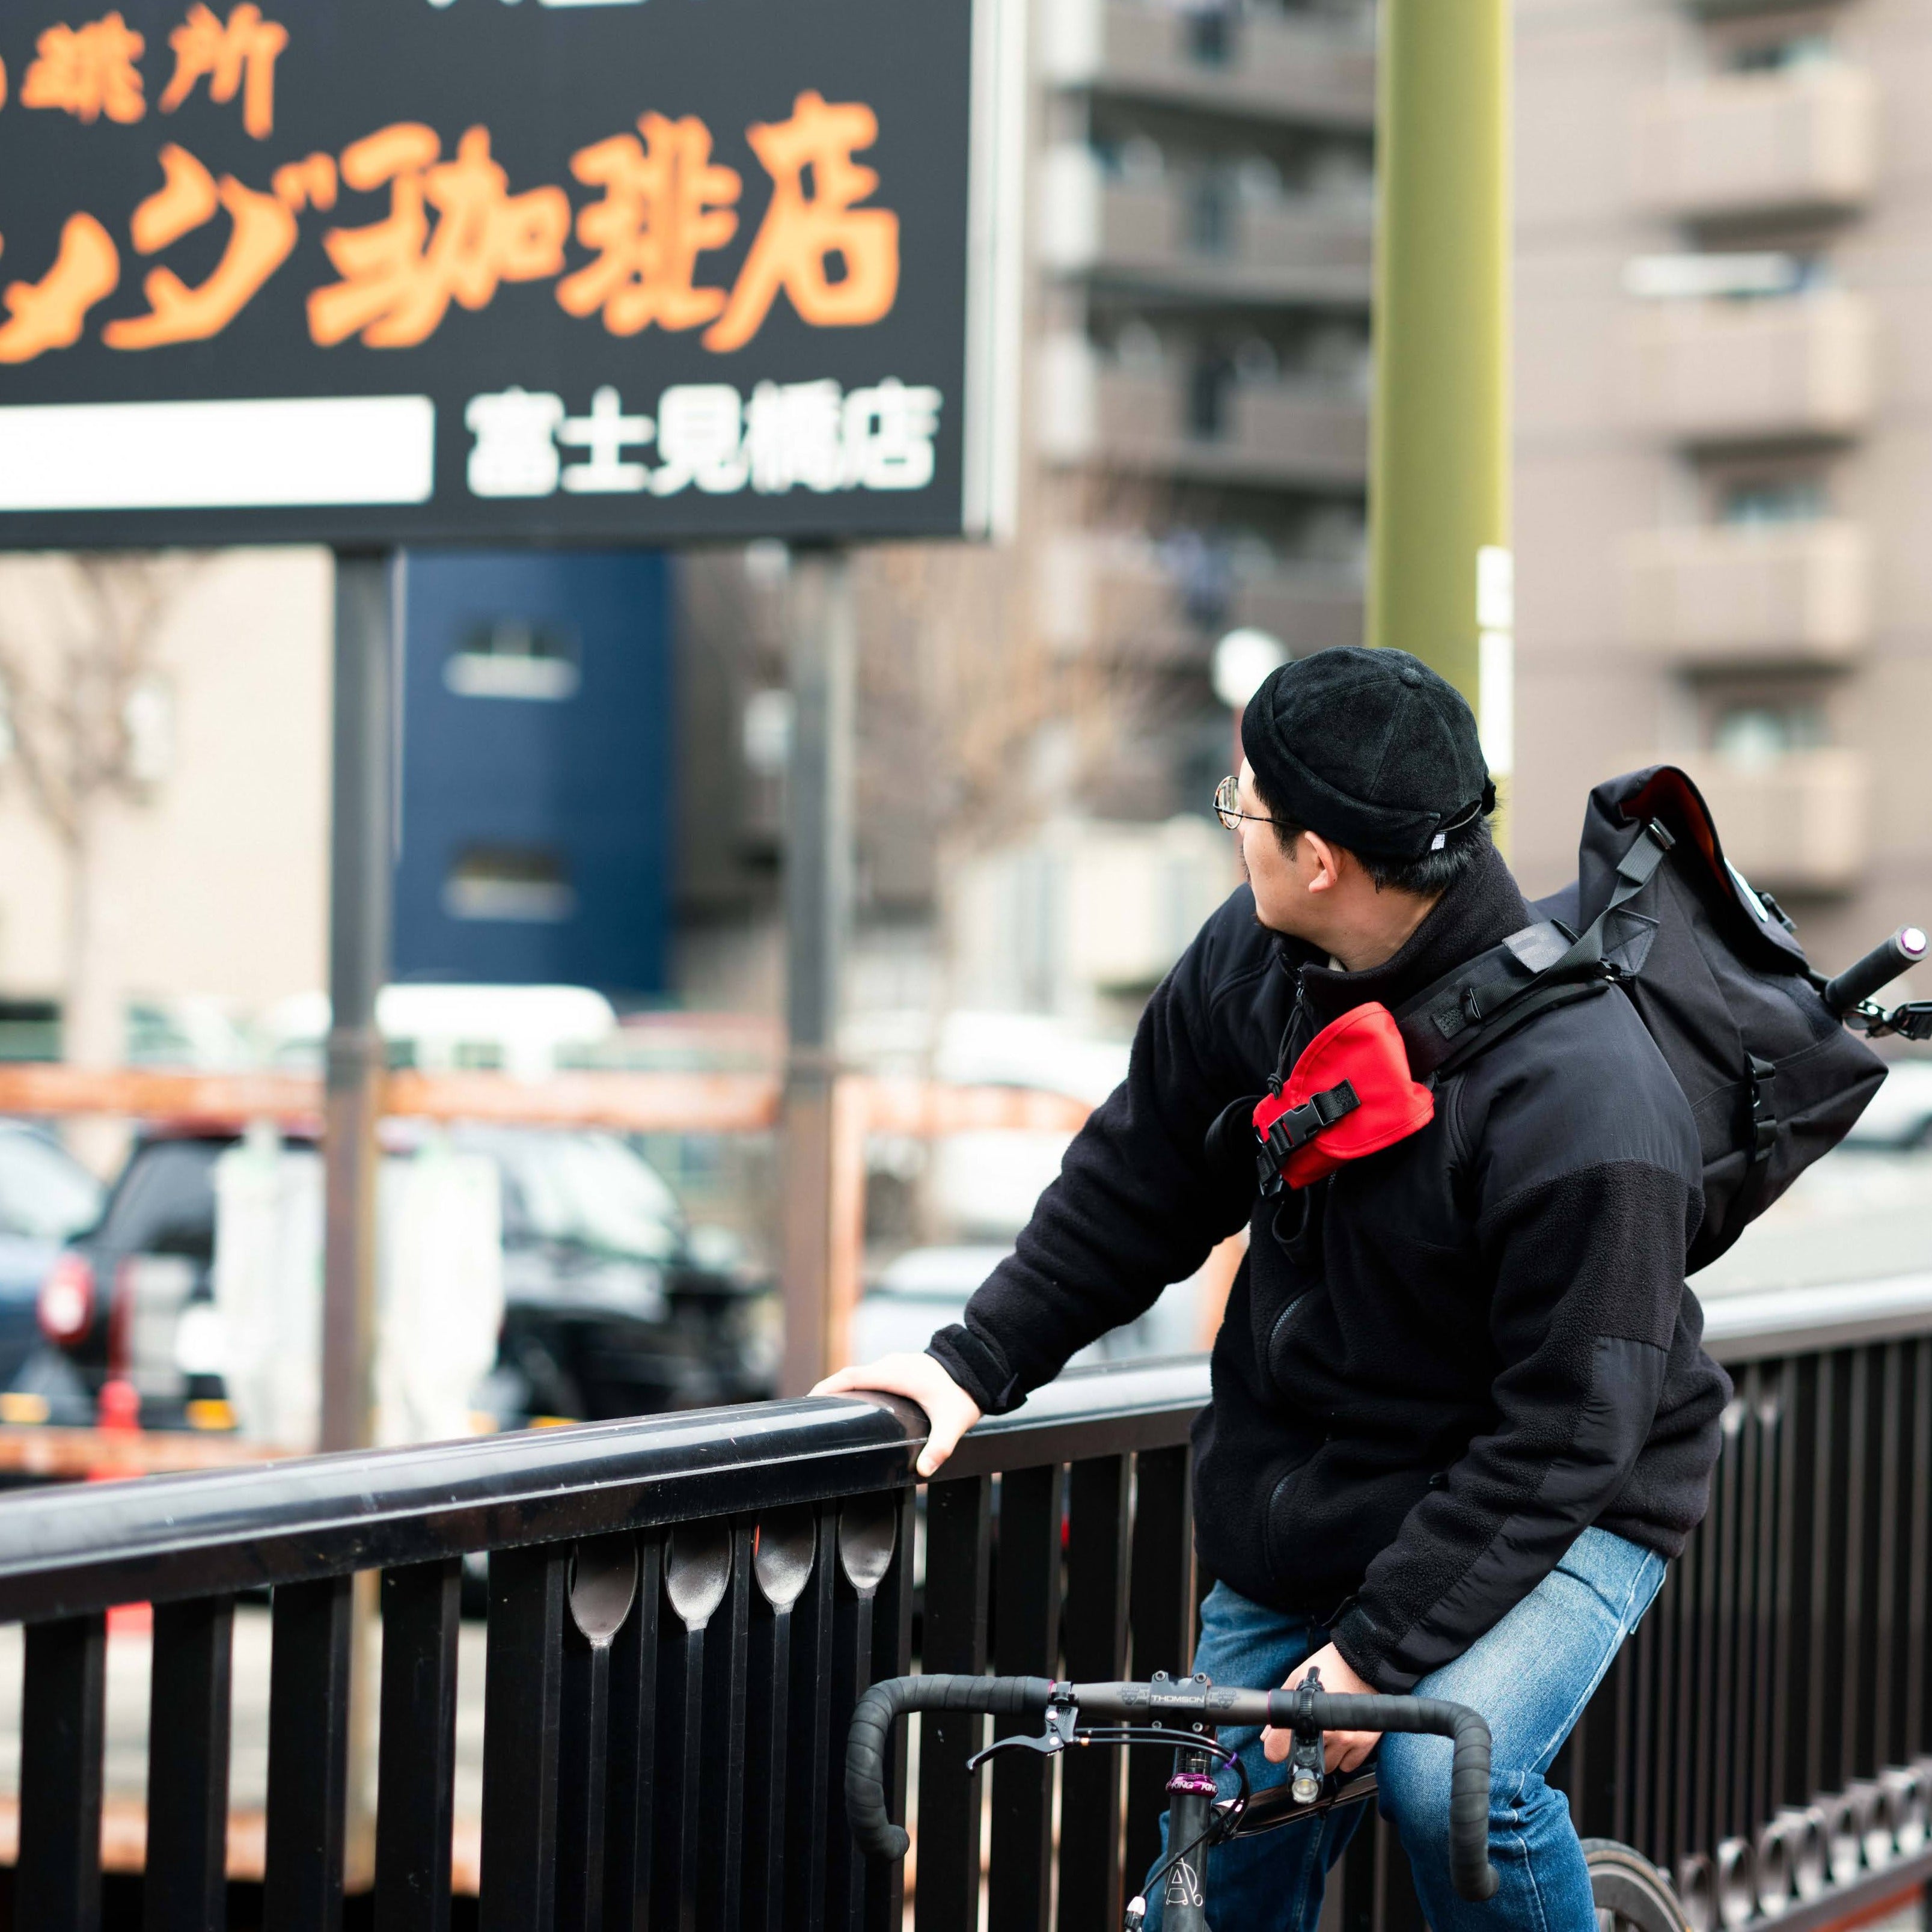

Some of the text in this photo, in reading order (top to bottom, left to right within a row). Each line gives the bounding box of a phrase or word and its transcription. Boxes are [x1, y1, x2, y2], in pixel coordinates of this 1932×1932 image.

[465, 378, 942, 497] 富士見橋店
[1151, 1695, 1205, 1703] THOMSON
